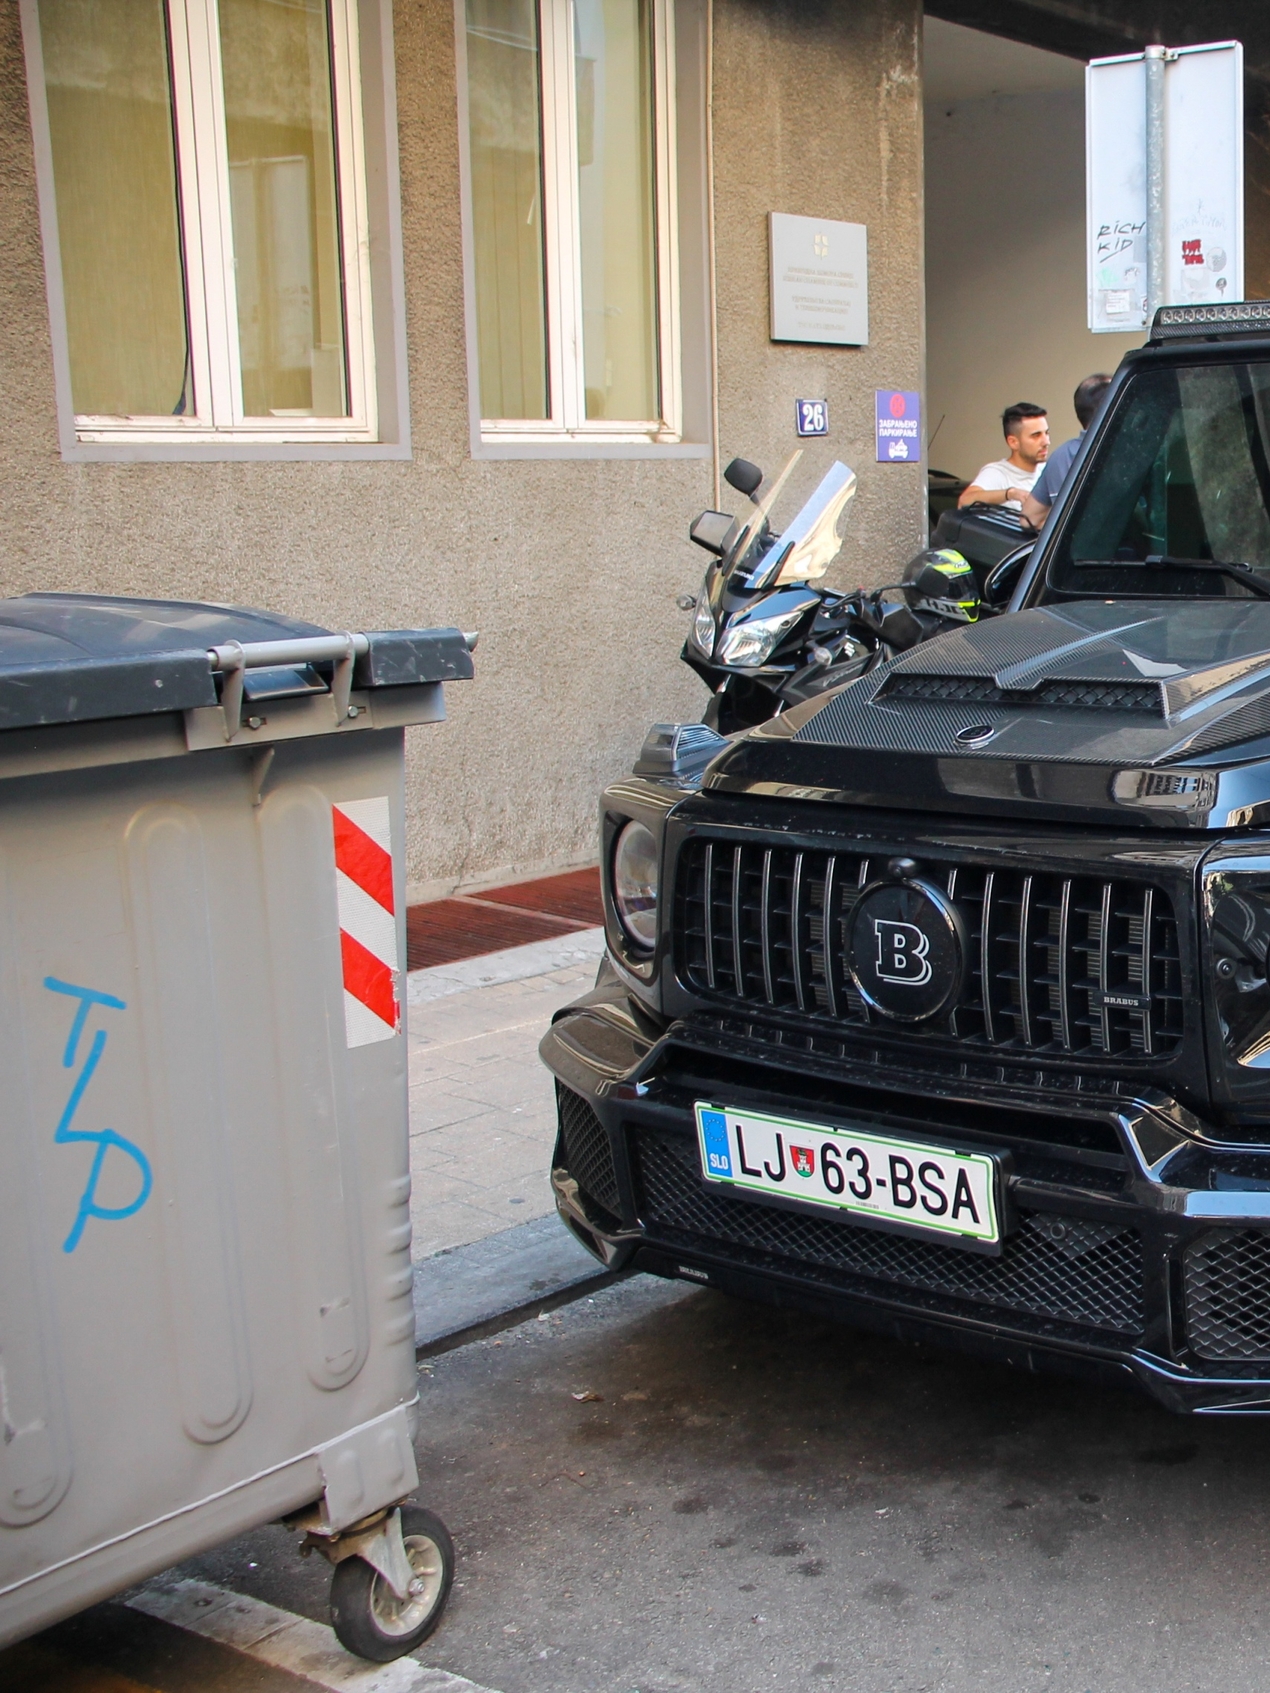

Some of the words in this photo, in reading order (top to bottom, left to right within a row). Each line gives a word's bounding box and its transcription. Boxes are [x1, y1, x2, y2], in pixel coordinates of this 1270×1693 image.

[1097, 220, 1147, 240] RICH
[1097, 237, 1134, 259] KID
[803, 404, 824, 431] 26
[879, 419, 918, 429] ЗАБРАЊЕНО
[879, 428, 918, 437] ПАРКИРАЊЕ
[874, 918, 932, 986] B
[1103, 996, 1139, 1007] BRABUS
[710, 1152, 729, 1171] SLO
[735, 1124, 787, 1182] LJ
[820, 1142, 981, 1224] 63-BSA
